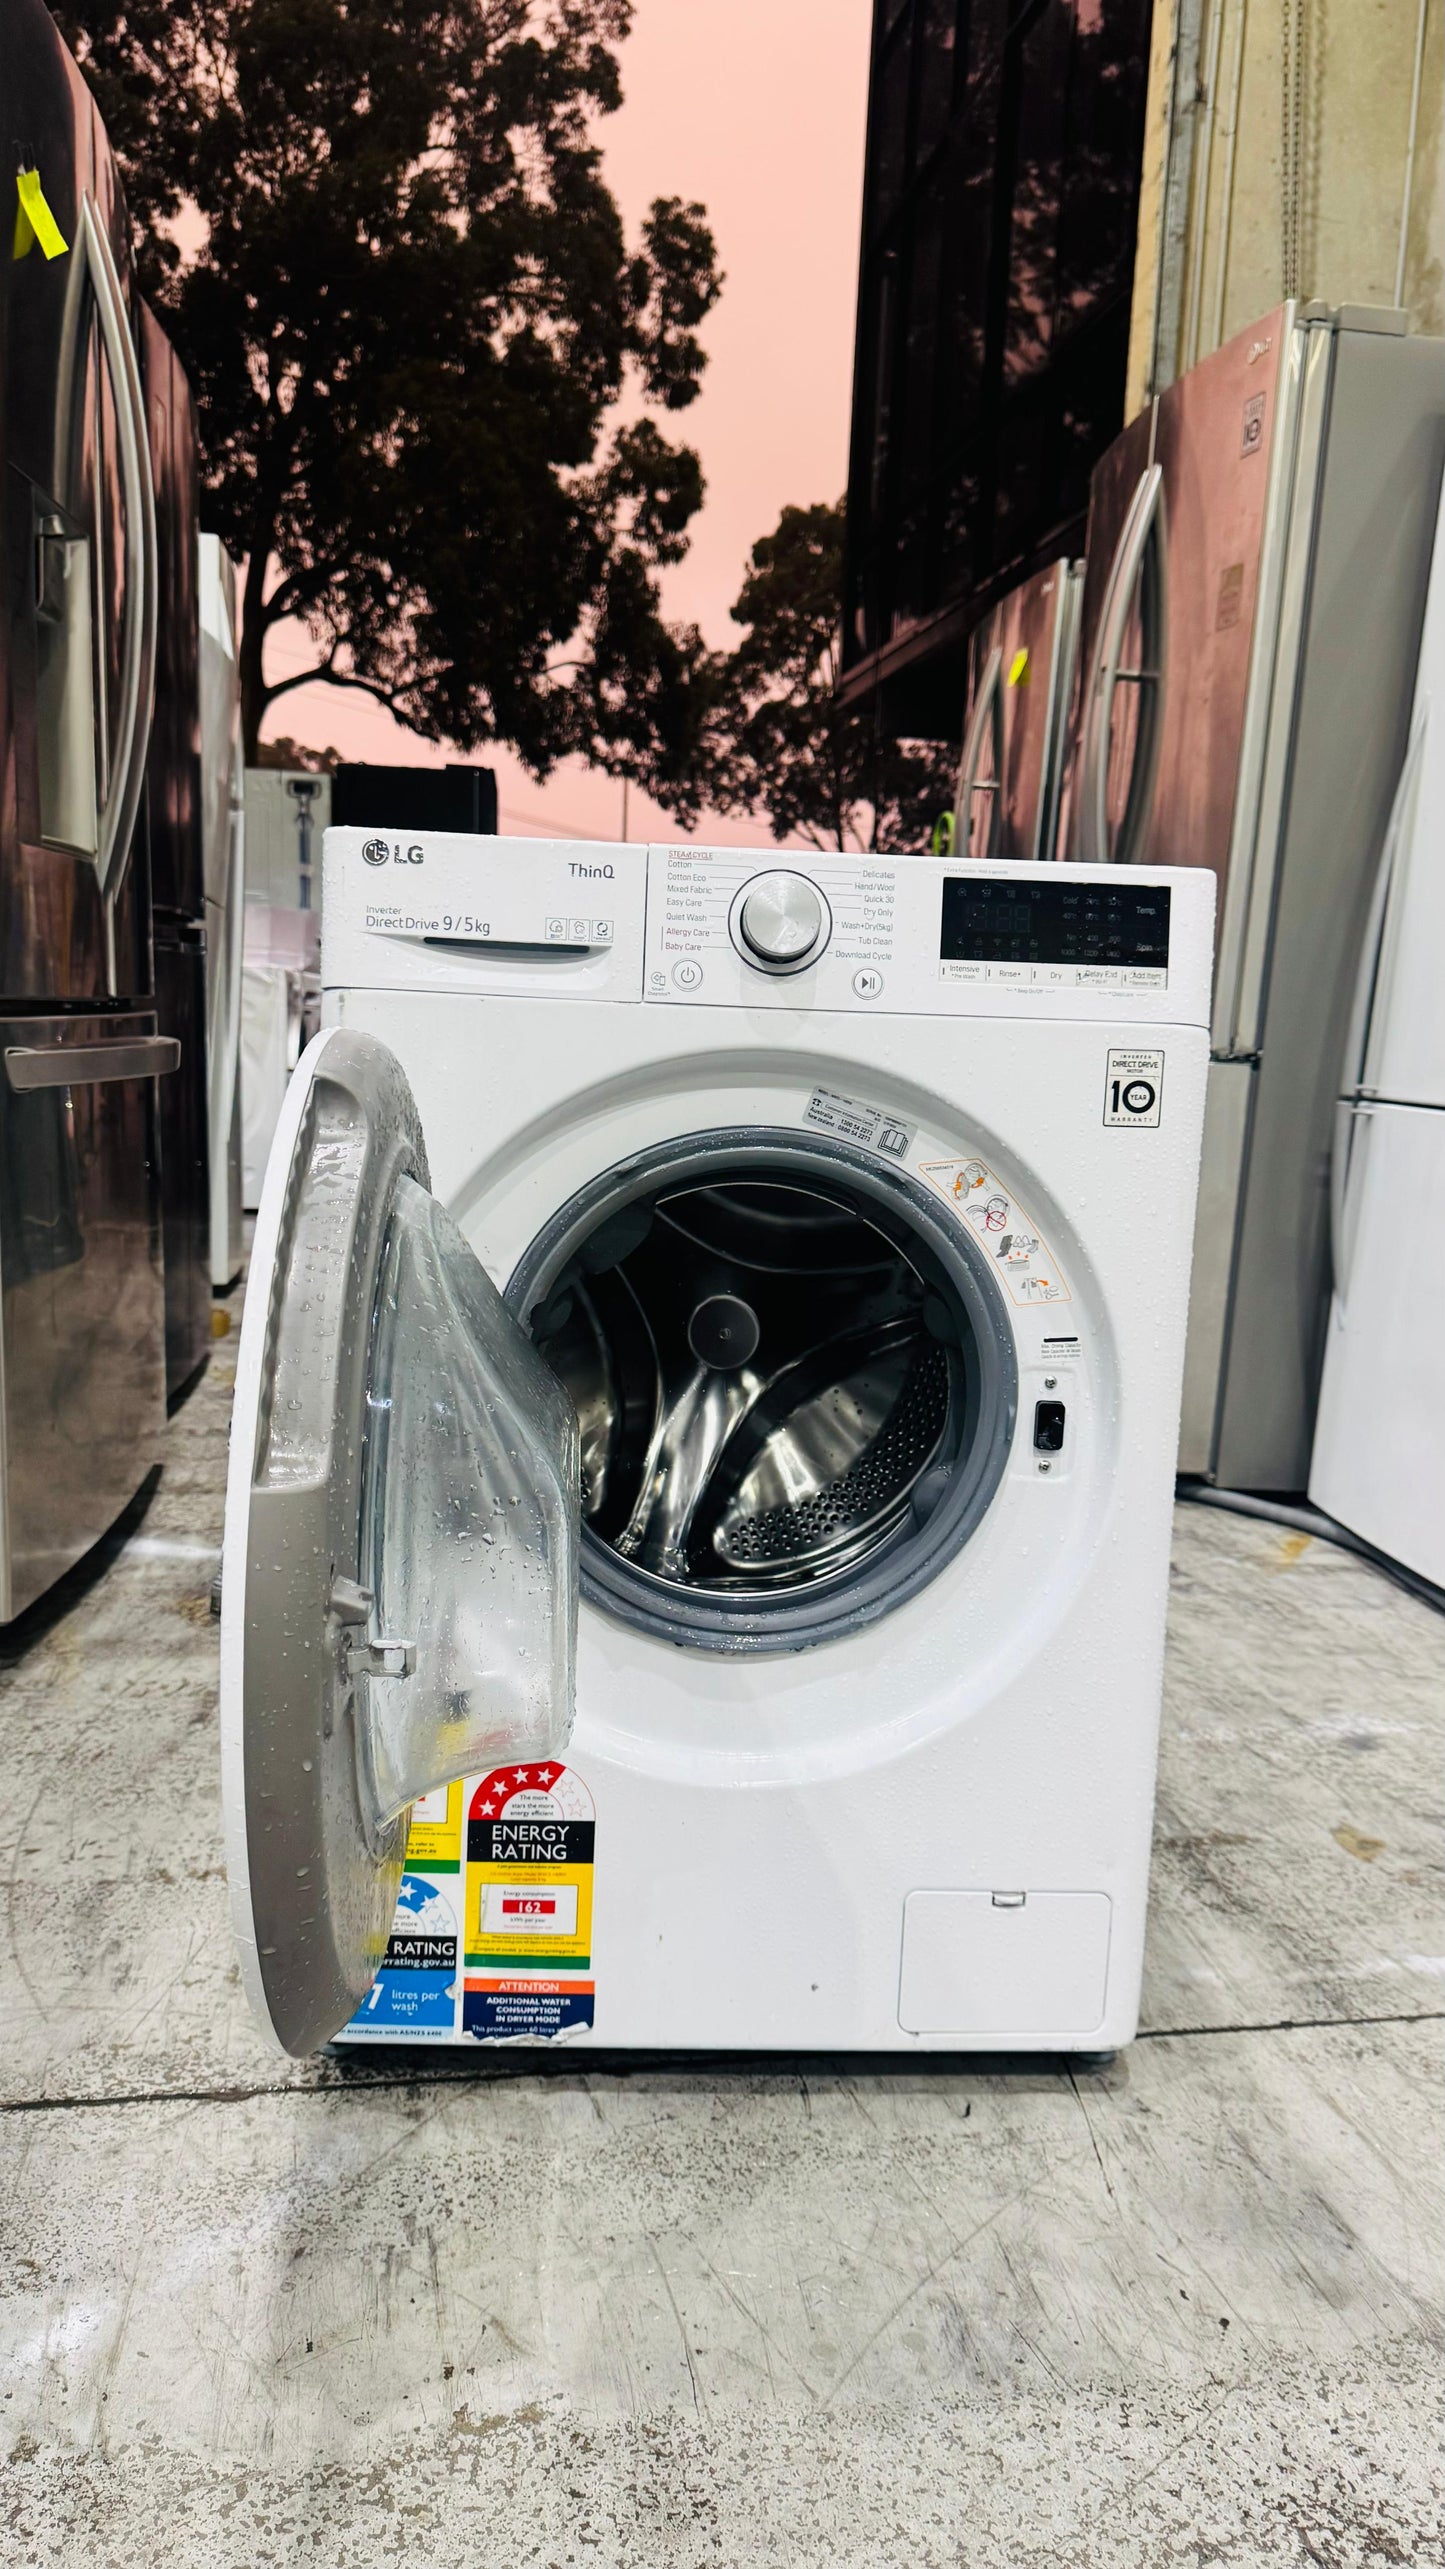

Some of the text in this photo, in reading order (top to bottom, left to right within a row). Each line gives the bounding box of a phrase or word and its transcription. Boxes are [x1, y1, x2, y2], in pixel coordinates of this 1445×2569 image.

[394, 845, 424, 864] LG
[668, 850, 713, 860] STEAM CYCLE
[667, 860, 692, 869] Cotton
[568, 862, 615, 879] ThinQ
[862, 869, 895, 879] Delicates
[667, 872, 706, 882] Cotton Eco
[667, 884, 713, 895] Mixed Fabric
[854, 883, 895, 892] Hand/Wool
[666, 898, 702, 907] Easy Care
[864, 895, 884, 903] Quick
[366, 905, 402, 915] Inverter
[863, 908, 893, 917] Dry Only
[666, 912, 707, 922] Quiet Wash
[666, 927, 710, 937] Allergy Care
[858, 936, 893, 946] Tub Clean
[665, 942, 702, 951] Baby Care
[835, 950, 892, 961] Download Cycle
[950, 964, 980, 973] Intensive
[1050, 971, 1063, 980] Dry
[1111, 1060, 1159, 1069] DIRECT DRIVE
[1111, 1080, 1156, 1114] 10
[809, 1106, 834, 1120] Australia
[492, 1825, 570, 1841] ENERGY
[492, 1843, 567, 1860] RATING
[518, 1901, 541, 1913] 162
[394, 1941, 455, 1955] RATING
[384, 1956, 455, 1968] rrating.gov.au
[499, 1981, 560, 1992] ATTENTION
[391, 1989, 418, 1999] litres
[421, 1991, 440, 2002] per
[391, 2001, 418, 2011] wash
[486, 1996, 571, 2006] ADDITIONAL WATER
[496, 2006, 561, 2014] CONSUMPTION
[507, 2015, 533, 2023] DRYER
[535, 2016, 560, 2024] MODE
[472, 2024, 485, 2032] This
[486, 2025, 512, 2034] product
